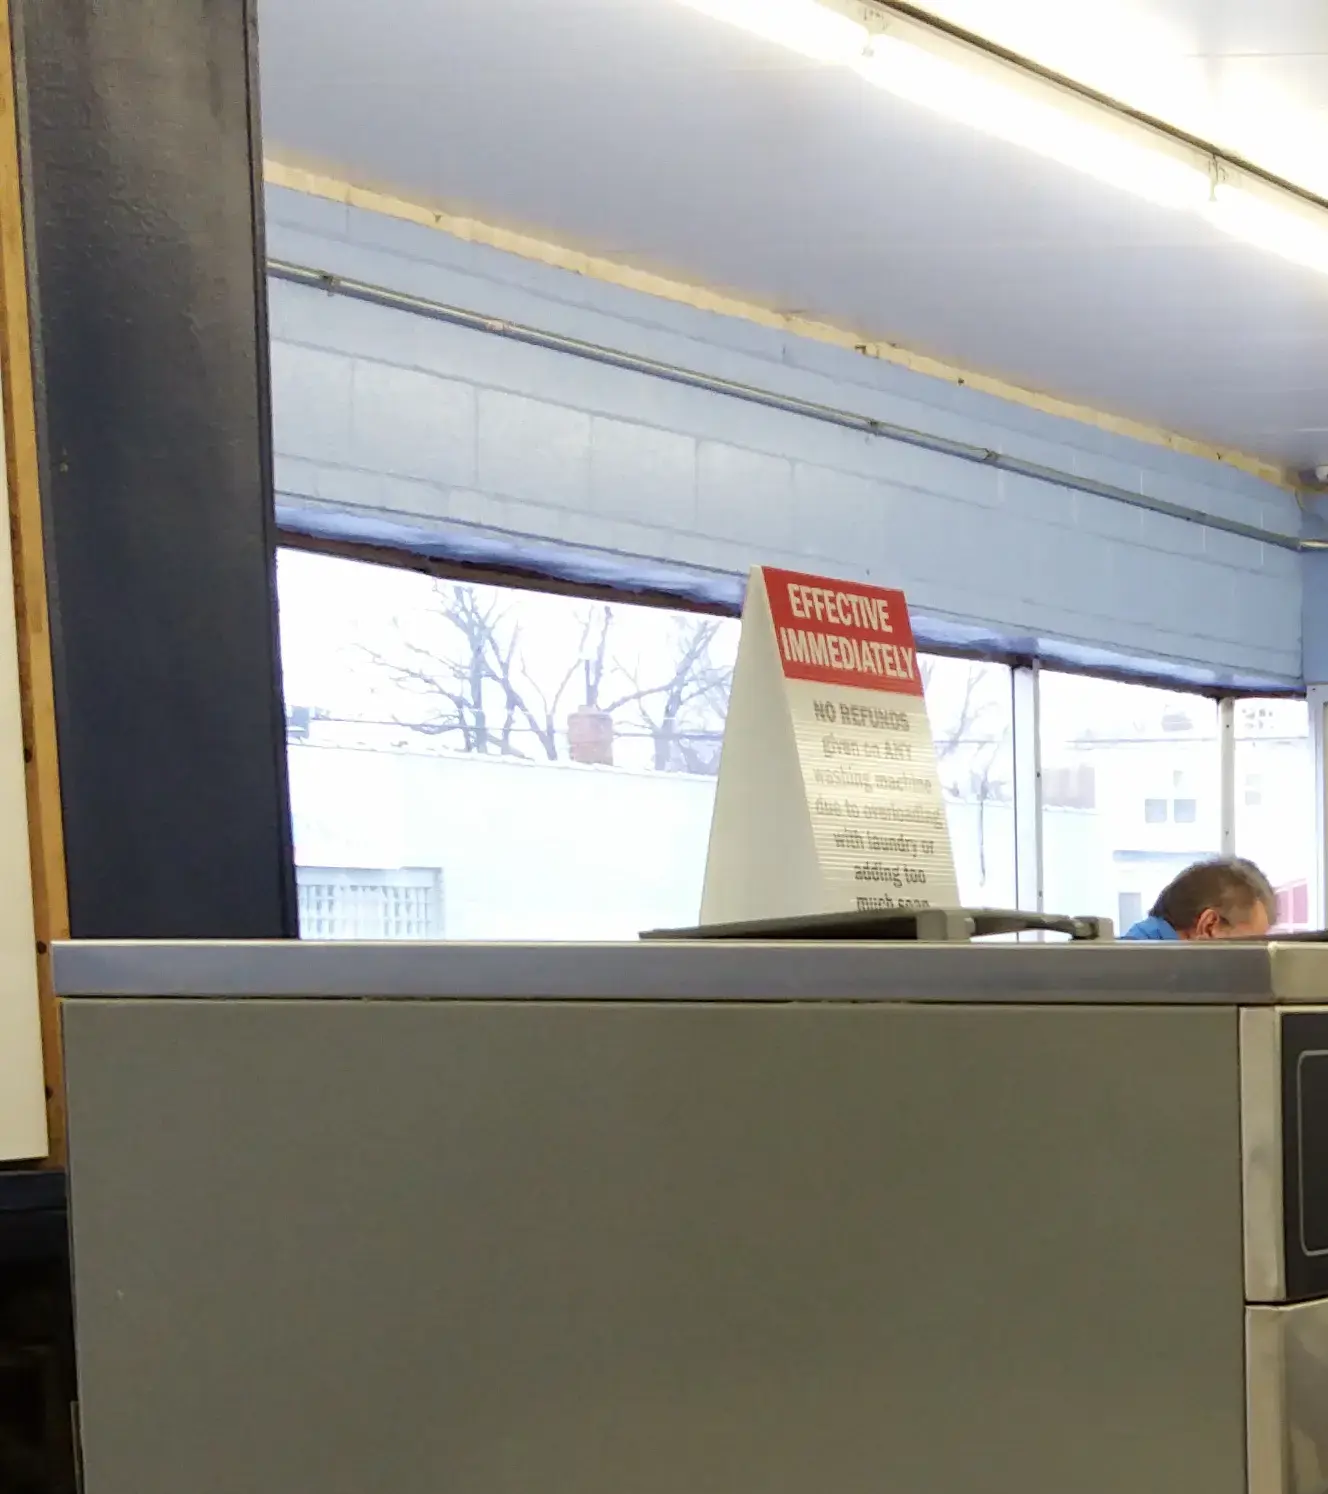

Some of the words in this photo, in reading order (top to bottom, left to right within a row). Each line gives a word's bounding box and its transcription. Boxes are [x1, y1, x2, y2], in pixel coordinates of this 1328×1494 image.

[787, 583, 893, 633] EFFECTIVE
[780, 627, 914, 680] IMMEDIATELY
[813, 700, 836, 723] NO
[840, 704, 910, 731] REFUNDS
[884, 742, 912, 760] ANY
[813, 766, 873, 793] washing
[874, 772, 932, 793] machine
[815, 797, 841, 816] due
[846, 799, 860, 817] to
[864, 802, 943, 829] overloading
[833, 828, 865, 848] with
[867, 831, 917, 857] laundry
[921, 840, 934, 854] or
[854, 861, 903, 888] adding
[904, 865, 926, 884] too
